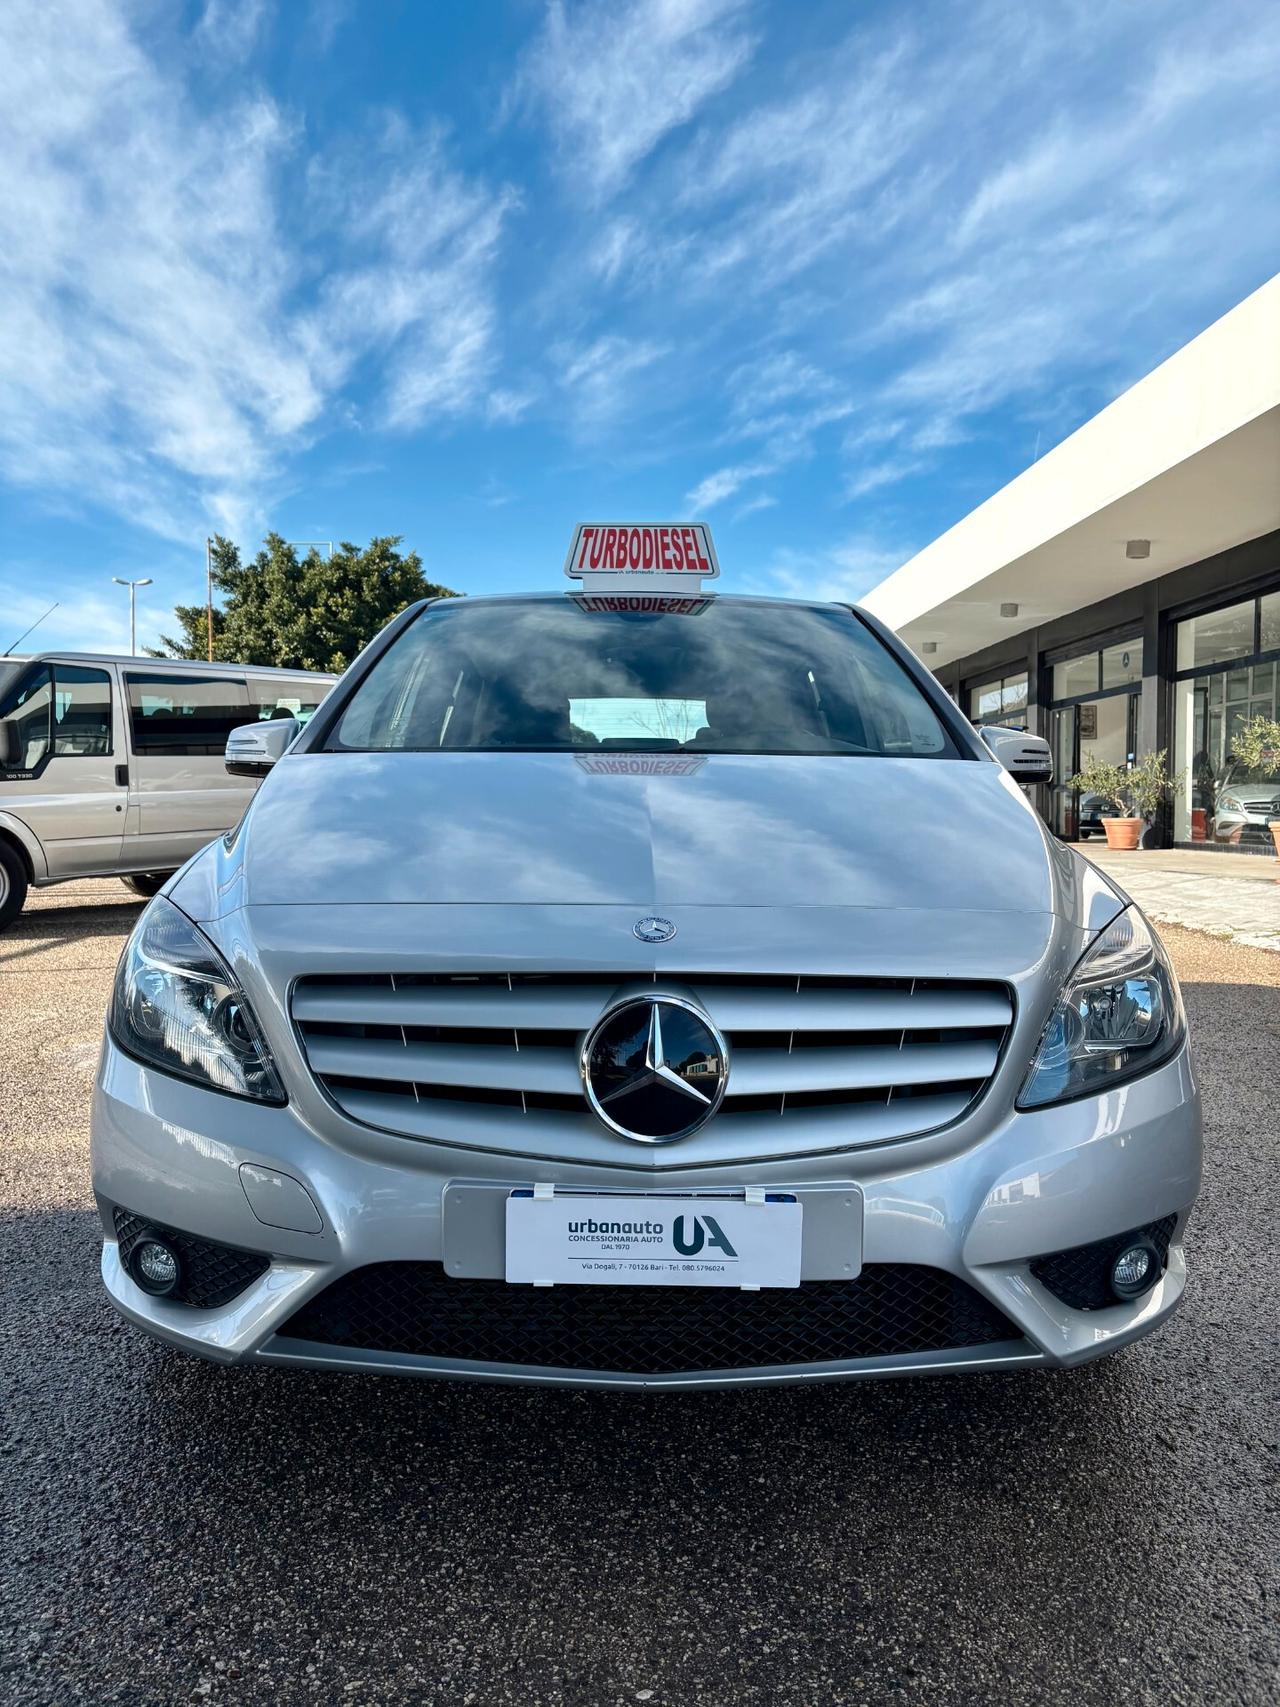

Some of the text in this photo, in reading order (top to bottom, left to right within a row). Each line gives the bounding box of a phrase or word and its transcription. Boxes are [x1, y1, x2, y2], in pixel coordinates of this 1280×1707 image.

[578, 528, 709, 570] TURBODIESEL
[568, 1218, 663, 1234] urbanauto
[568, 1235, 639, 1243] CONCESSIONARIA
[673, 1215, 739, 1257] UA
